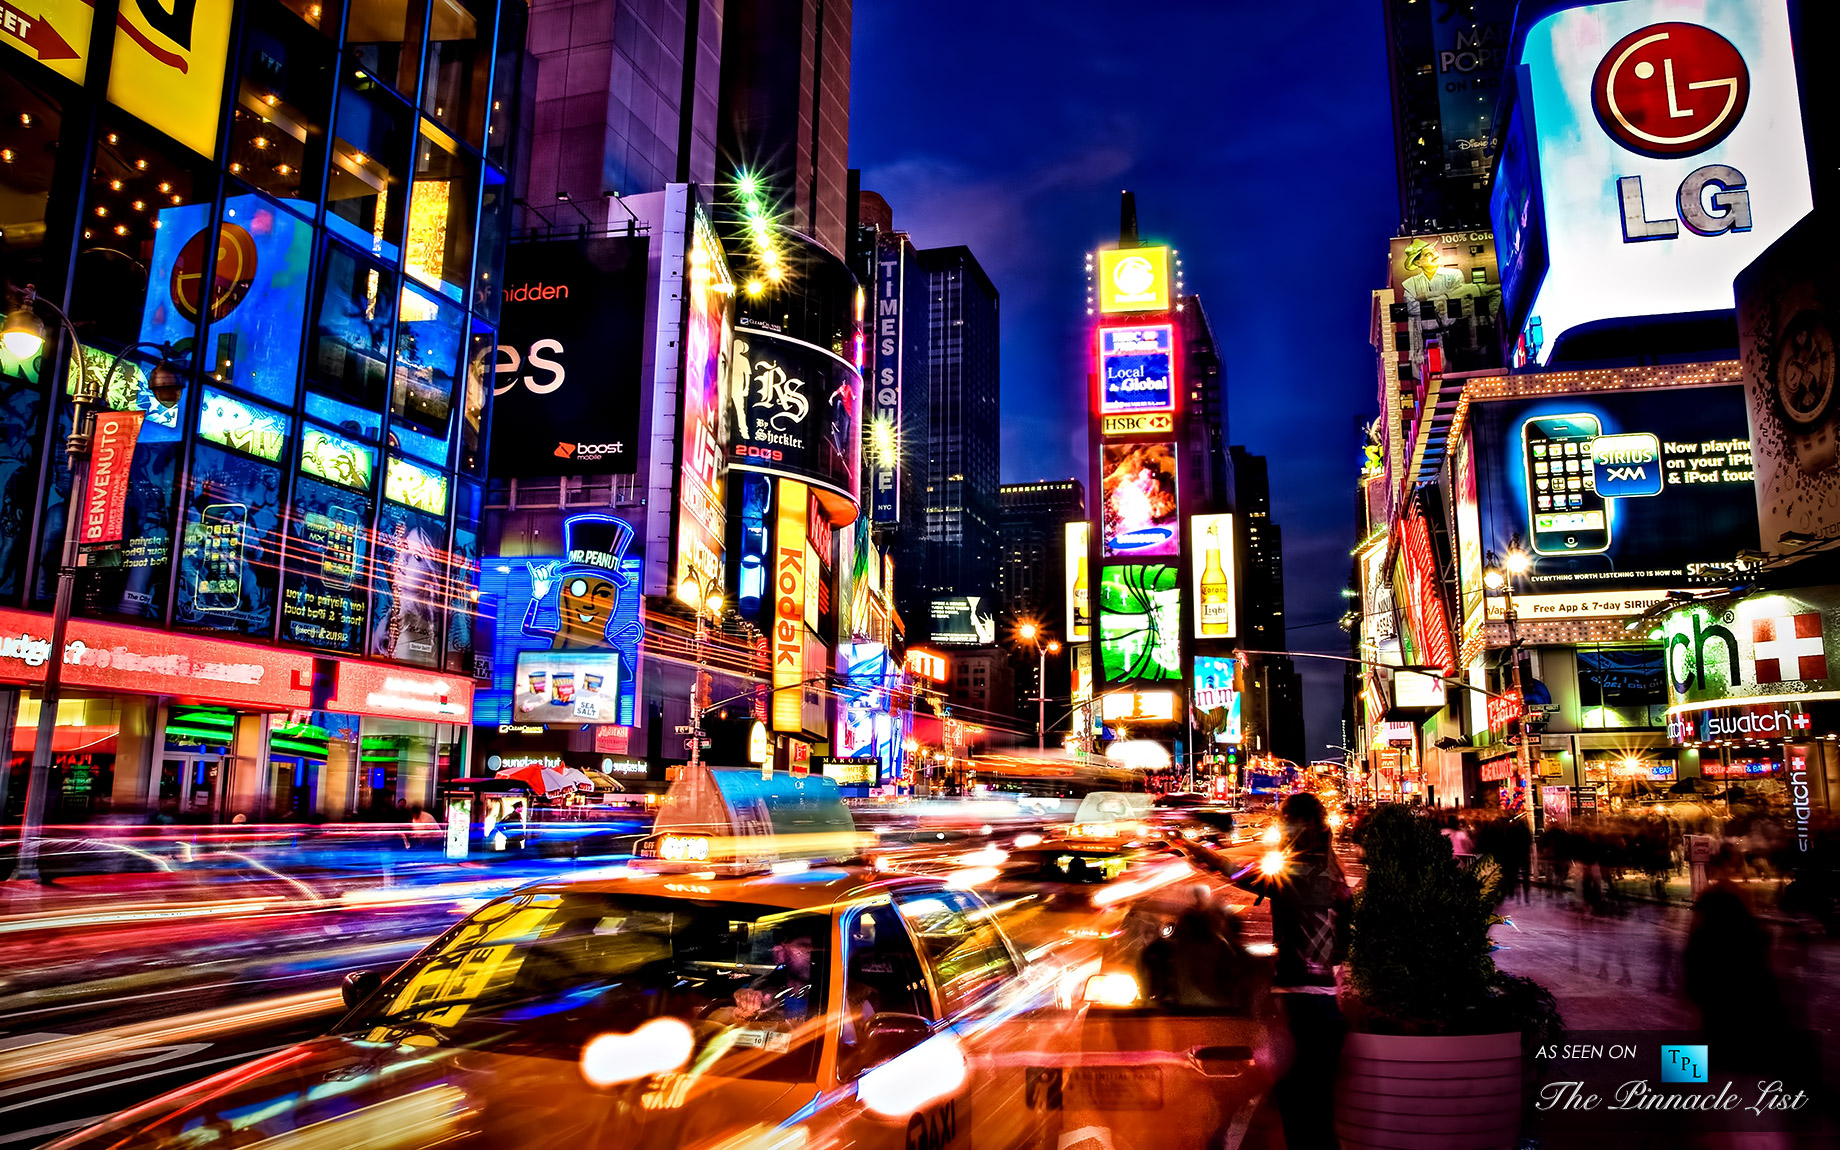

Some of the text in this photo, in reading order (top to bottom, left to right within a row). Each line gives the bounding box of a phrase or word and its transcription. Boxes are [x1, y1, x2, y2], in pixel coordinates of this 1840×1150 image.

[0, 6, 31, 38] ET
[1616, 164, 1752, 244] LG
[1441, 233, 1467, 244] 100%
[878, 261, 898, 490] TIMES SQUE
[1108, 365, 1144, 378] Local
[1121, 376, 1167, 392] Global
[752, 360, 809, 431] RS
[756, 419, 769, 430] By
[1105, 417, 1147, 430] HSBC
[577, 441, 623, 455] boost
[735, 445, 783, 461] 2009
[1664, 442, 1698, 454] Now
[1599, 449, 1653, 466] SIRIUS
[1666, 459, 1685, 469] on
[1688, 457, 1725, 470] your
[87, 420, 119, 539] BENVENUTO
[1606, 466, 1647, 482] XM
[1668, 472, 1681, 484] &
[1684, 470, 1719, 484] iPod
[108, 508, 116, 535] TIMES
[585, 550, 619, 571] PEANUT
[1531, 574, 1572, 582] EVERYTHING
[1600, 571, 1634, 579] LISTENING
[777, 546, 803, 666] Kodak
[1204, 604, 1227, 616] Light
[1533, 605, 1555, 613] Free
[1559, 604, 1578, 613] App
[1592, 602, 1620, 611] 7-day
[576, 707, 596, 716] SALT
[580, 701, 594, 710] SEA
[1708, 710, 1792, 735] swatch
[544, 756, 561, 768] hut
[1658, 766, 1673, 775] BAR
[643, 841, 655, 850] OFF
